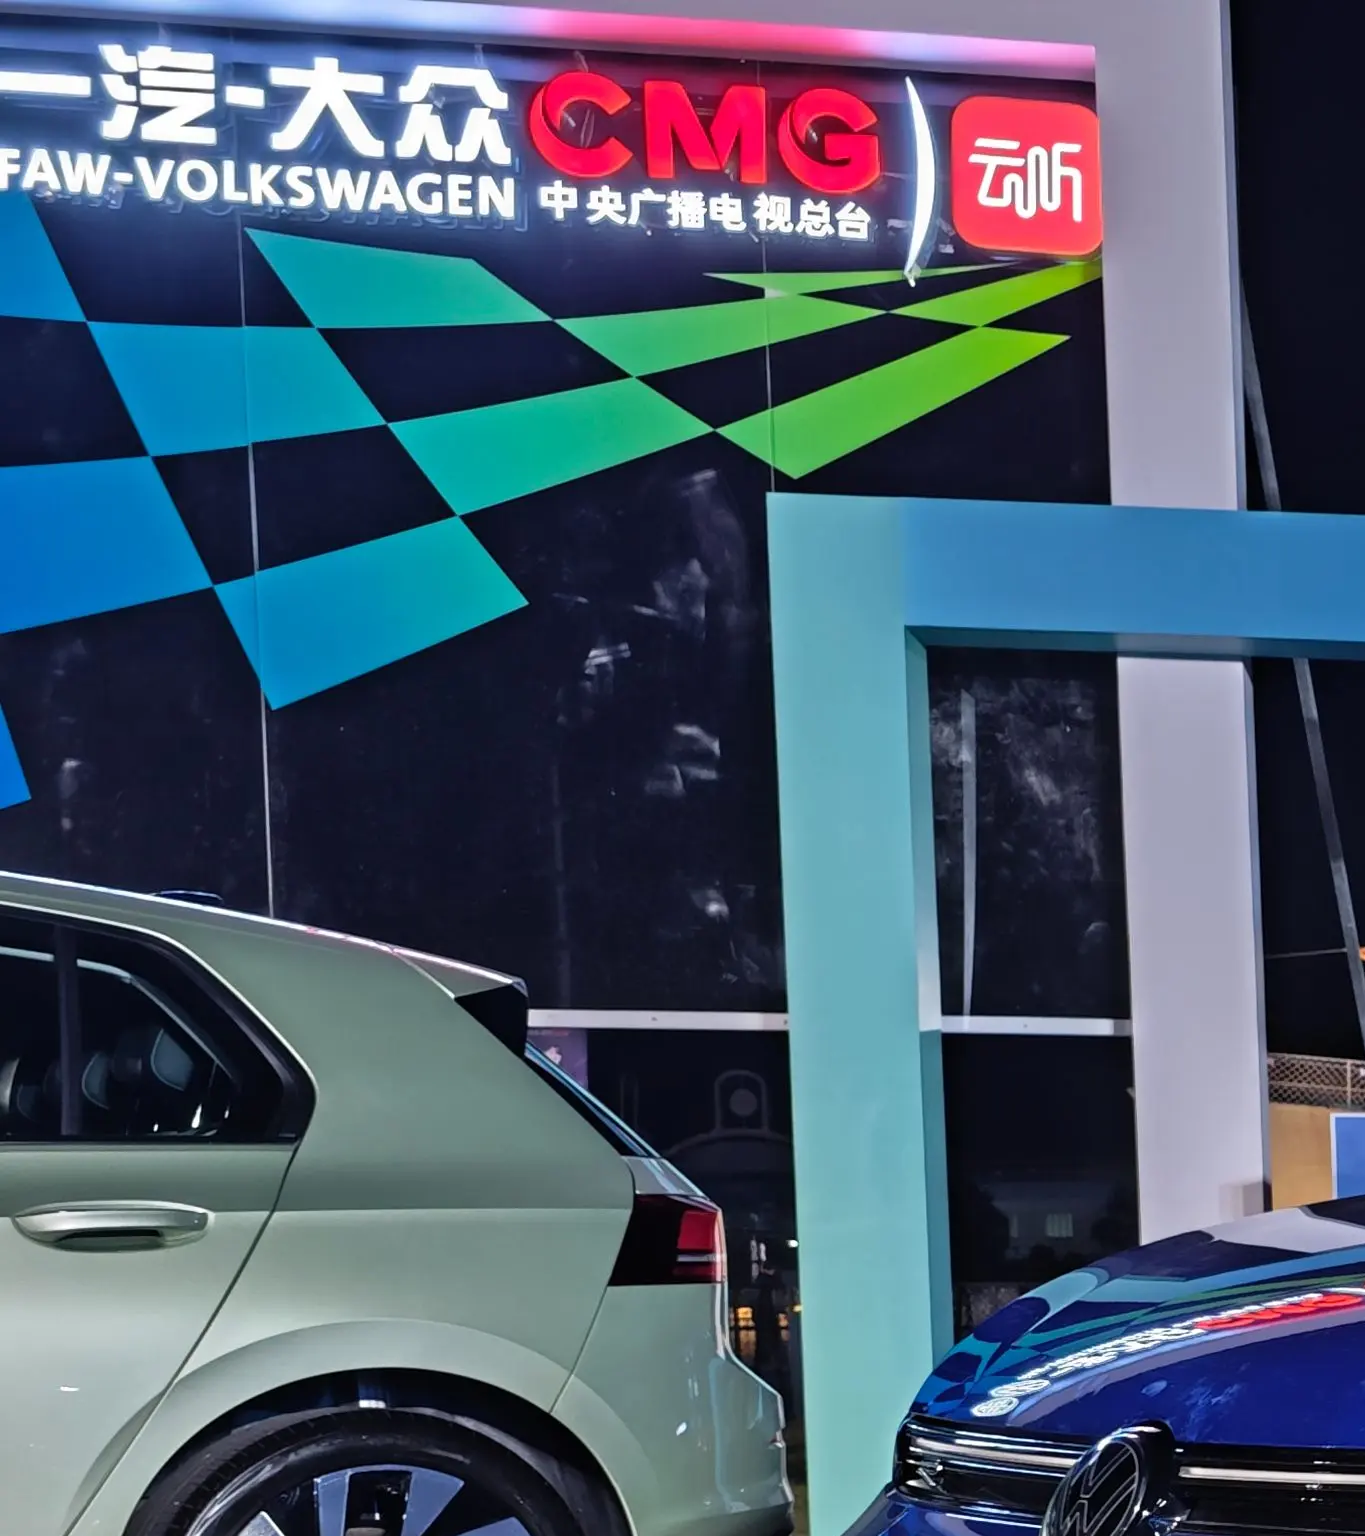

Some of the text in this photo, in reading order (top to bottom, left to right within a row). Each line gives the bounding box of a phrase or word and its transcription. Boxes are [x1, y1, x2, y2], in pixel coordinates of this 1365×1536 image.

[0, 43, 512, 165] 一汽-大众
[529, 70, 882, 195] CMG
[0, 147, 515, 219] FAW-VOLKSWAGEN
[538, 179, 873, 241] 中央广播电视总台
[968, 137, 1082, 223] 云听
